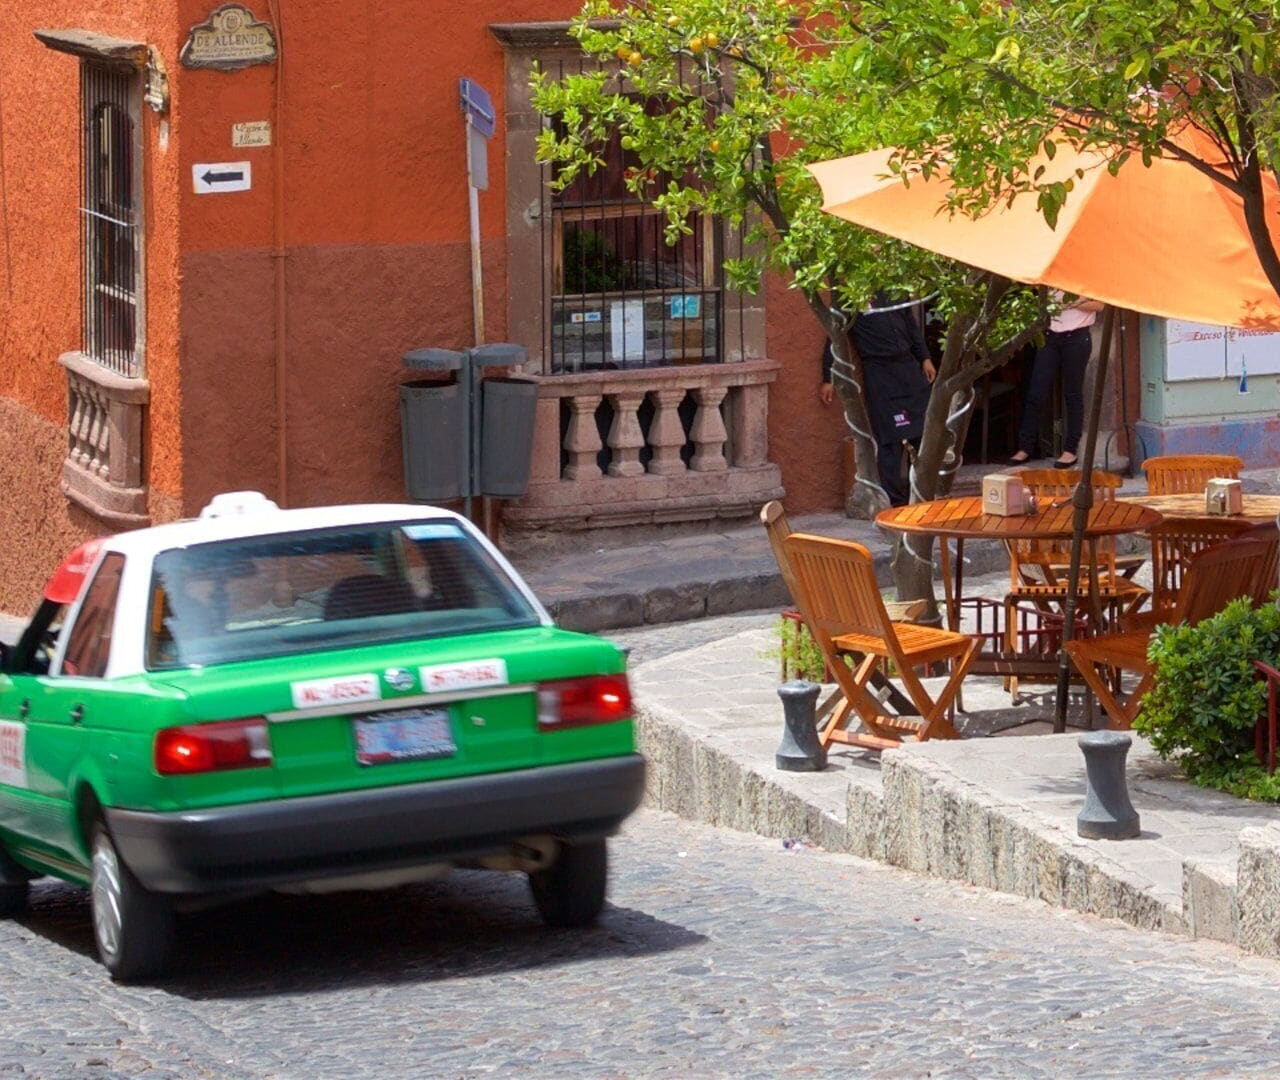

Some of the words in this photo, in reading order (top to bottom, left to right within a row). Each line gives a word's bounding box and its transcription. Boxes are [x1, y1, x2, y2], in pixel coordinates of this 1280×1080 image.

[196, 36, 210, 48] DE
[214, 33, 265, 46] ALLENDE
[1193, 331, 1222, 340] Exceso
